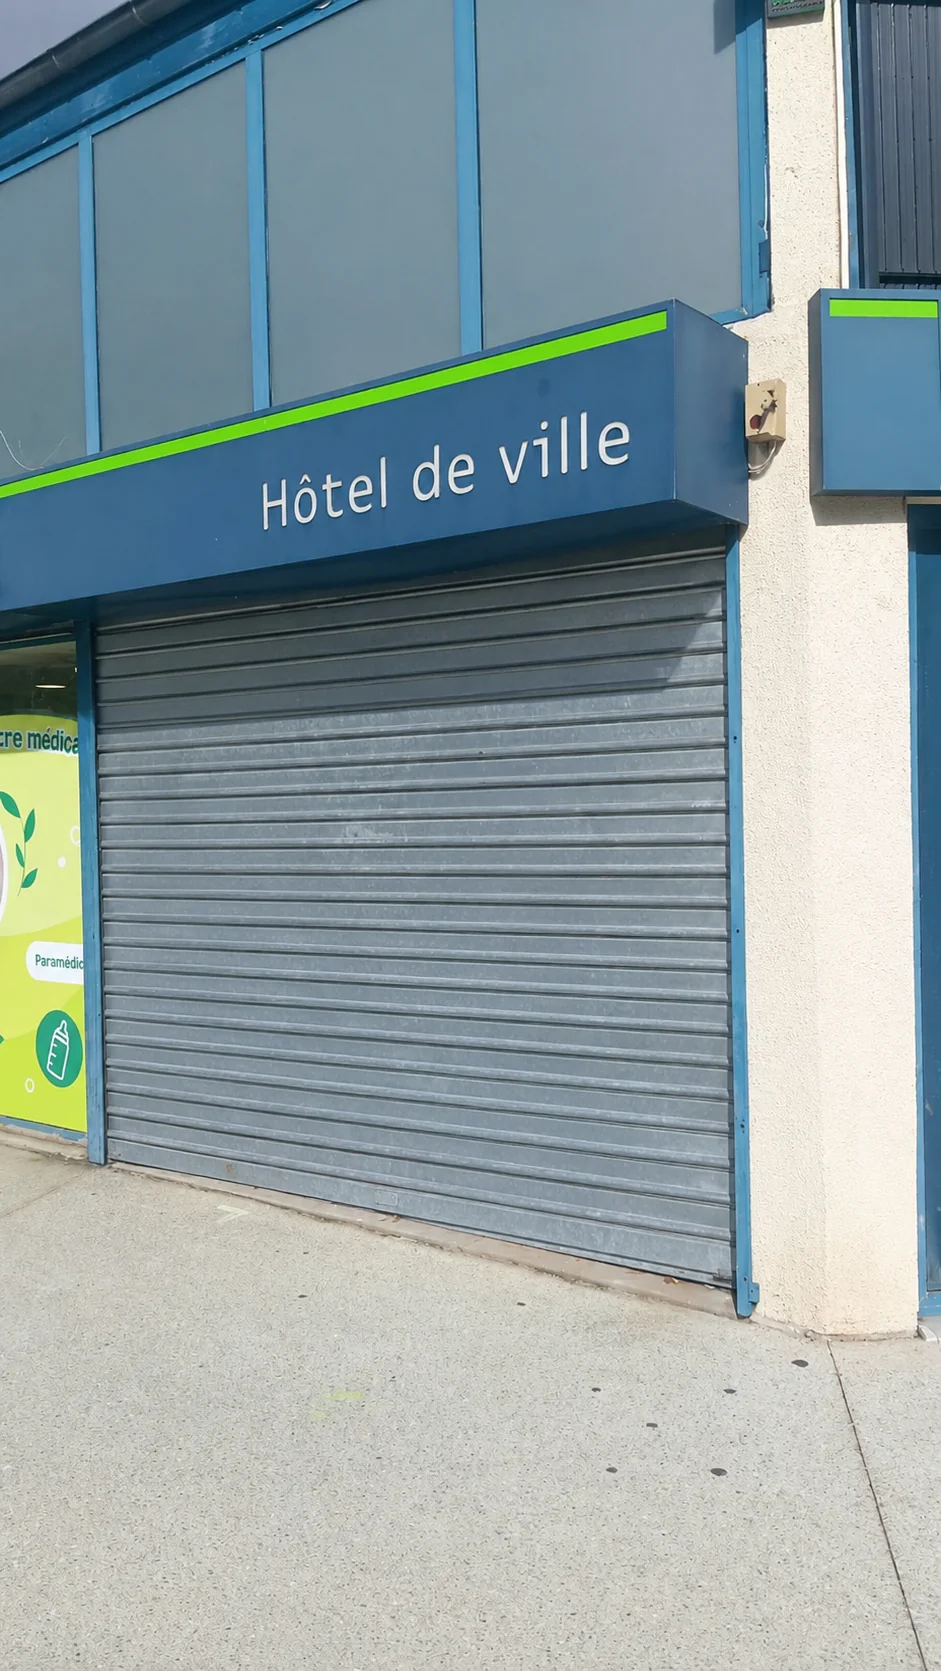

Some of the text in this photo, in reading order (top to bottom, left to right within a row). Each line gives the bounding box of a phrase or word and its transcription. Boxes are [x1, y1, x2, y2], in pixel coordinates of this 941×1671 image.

[262, 411, 630, 531] Hôtel de ville
